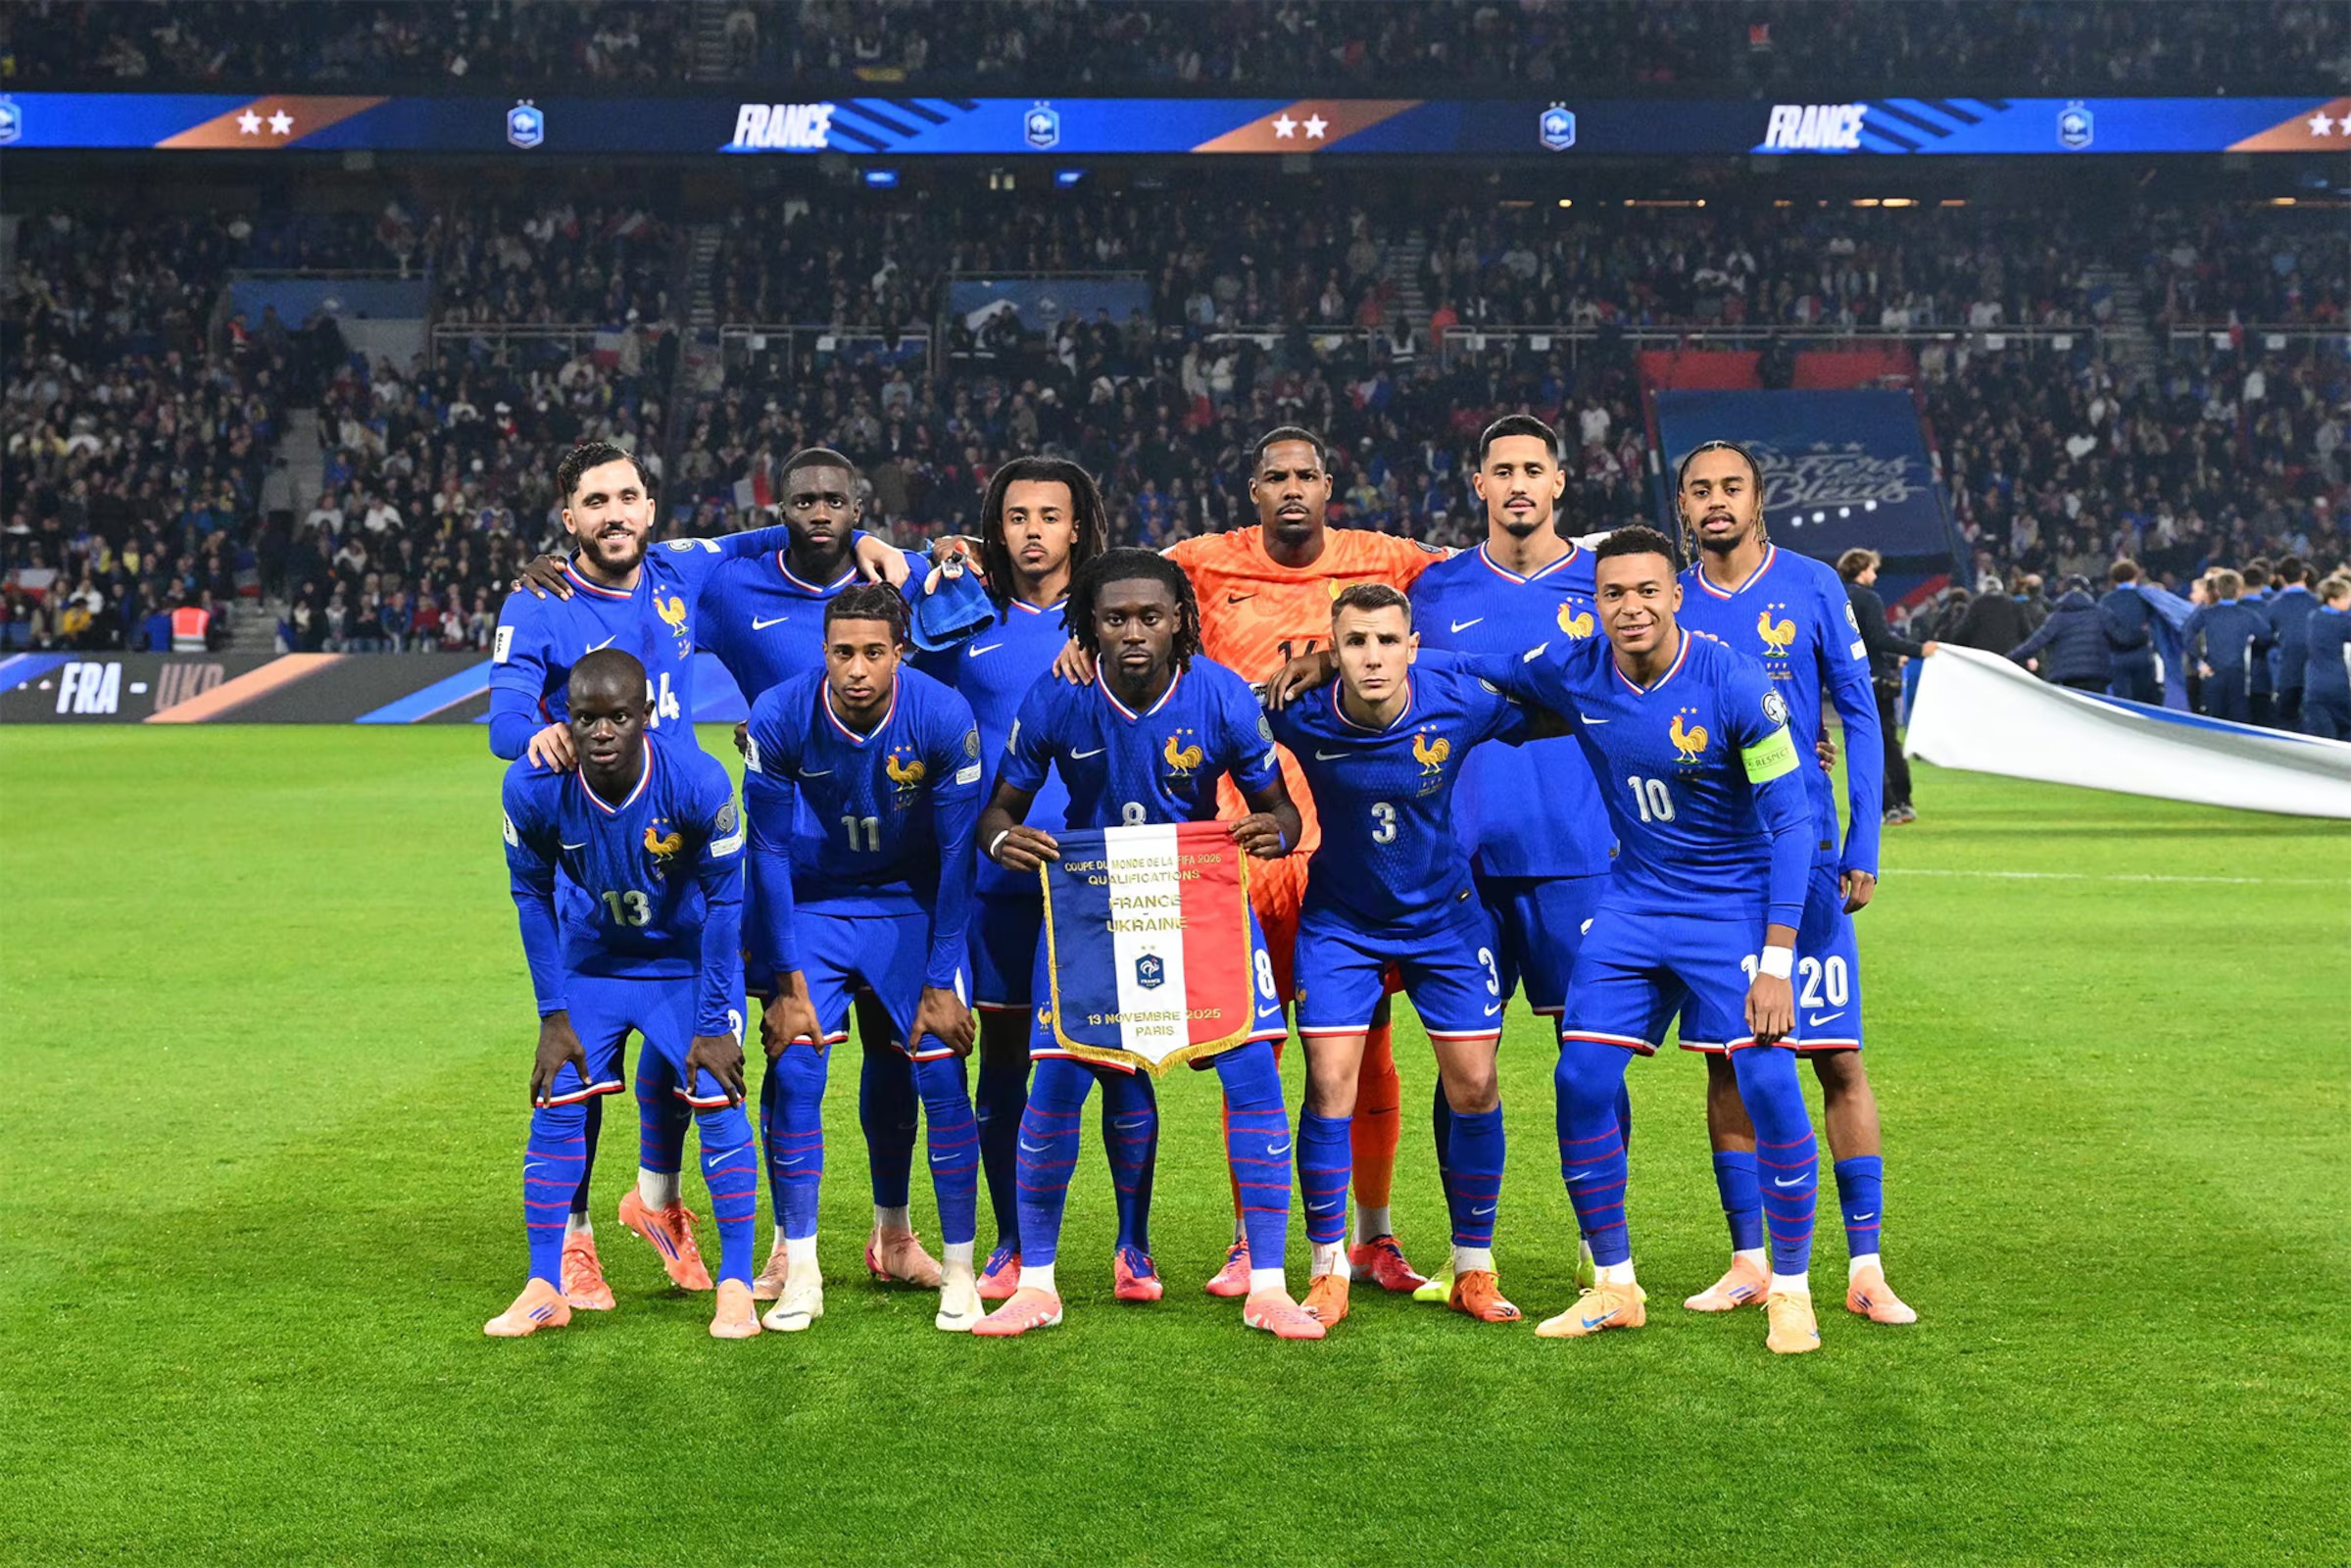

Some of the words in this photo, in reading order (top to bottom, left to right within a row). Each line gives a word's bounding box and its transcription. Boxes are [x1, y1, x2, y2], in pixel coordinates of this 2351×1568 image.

[733, 104, 835, 148] FRANCE
[1765, 104, 1867, 149] FRANCE
[56, 662, 122, 713] FRA
[1627, 775, 1676, 822] 10
[841, 815, 880, 852] 11
[1372, 802, 1396, 844] 3
[1064, 860, 1095, 872] COUPE
[1097, 860, 1108, 870] DU
[1111, 858, 1145, 869] MONDE
[1147, 857, 1160, 868] DE
[1161, 856, 1174, 866] LA
[1178, 855, 1196, 865] FIFA
[1198, 854, 1221, 864] 2026
[1088, 869, 1200, 886] QUALIFICATIONS
[602, 890, 652, 926] 13
[1108, 894, 1183, 910] FRANCE
[1105, 915, 1188, 933] UKRAINE
[1254, 949, 1276, 1000] 8
[1478, 947, 1499, 996] 3
[1798, 955, 1849, 1008] 20
[1087, 1013, 1102, 1025] 13
[1104, 1010, 1181, 1025] NOVEMBRE
[1186, 1008, 1222, 1020] 2025
[1135, 1025, 1175, 1037] PARIS
